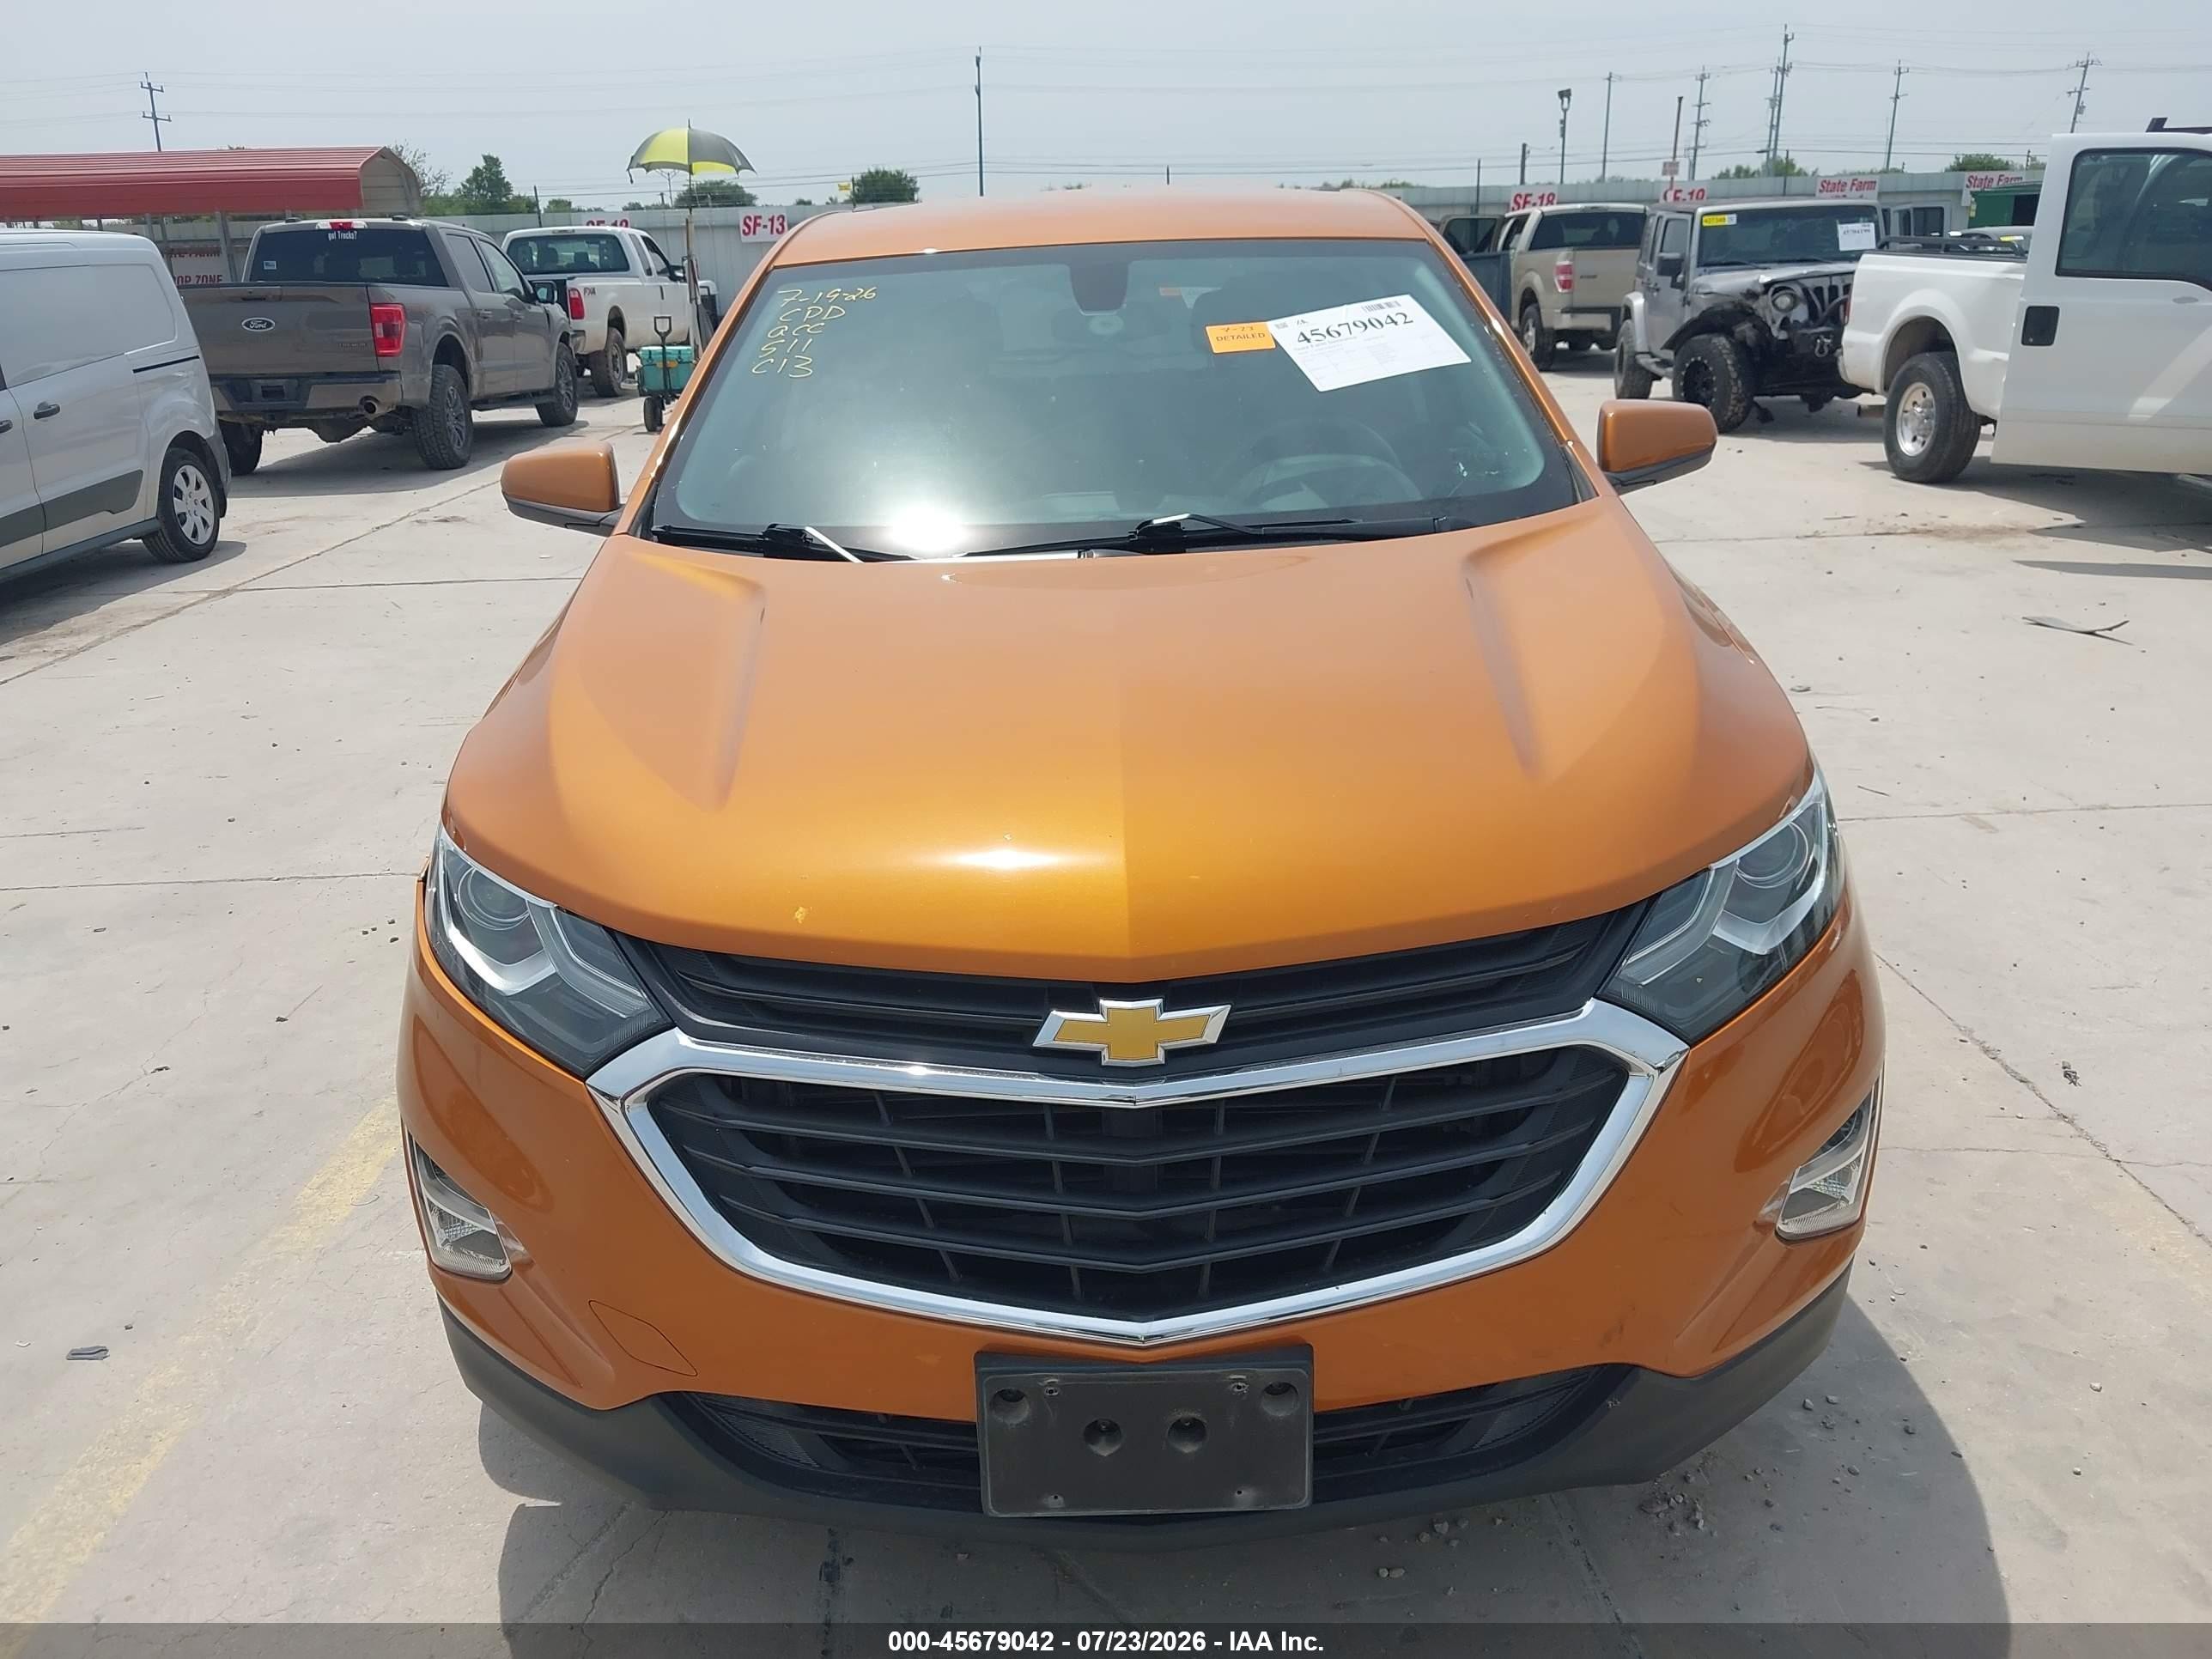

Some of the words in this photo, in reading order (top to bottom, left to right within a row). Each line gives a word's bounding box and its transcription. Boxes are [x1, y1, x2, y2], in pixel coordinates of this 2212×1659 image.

[1818, 179, 1847, 193] State
[1849, 178, 1877, 191] Farm
[741, 215, 787, 236] SF-13
[1297, 311, 1414, 343] 45679042
[1216, 332, 1266, 342] DETAILED
